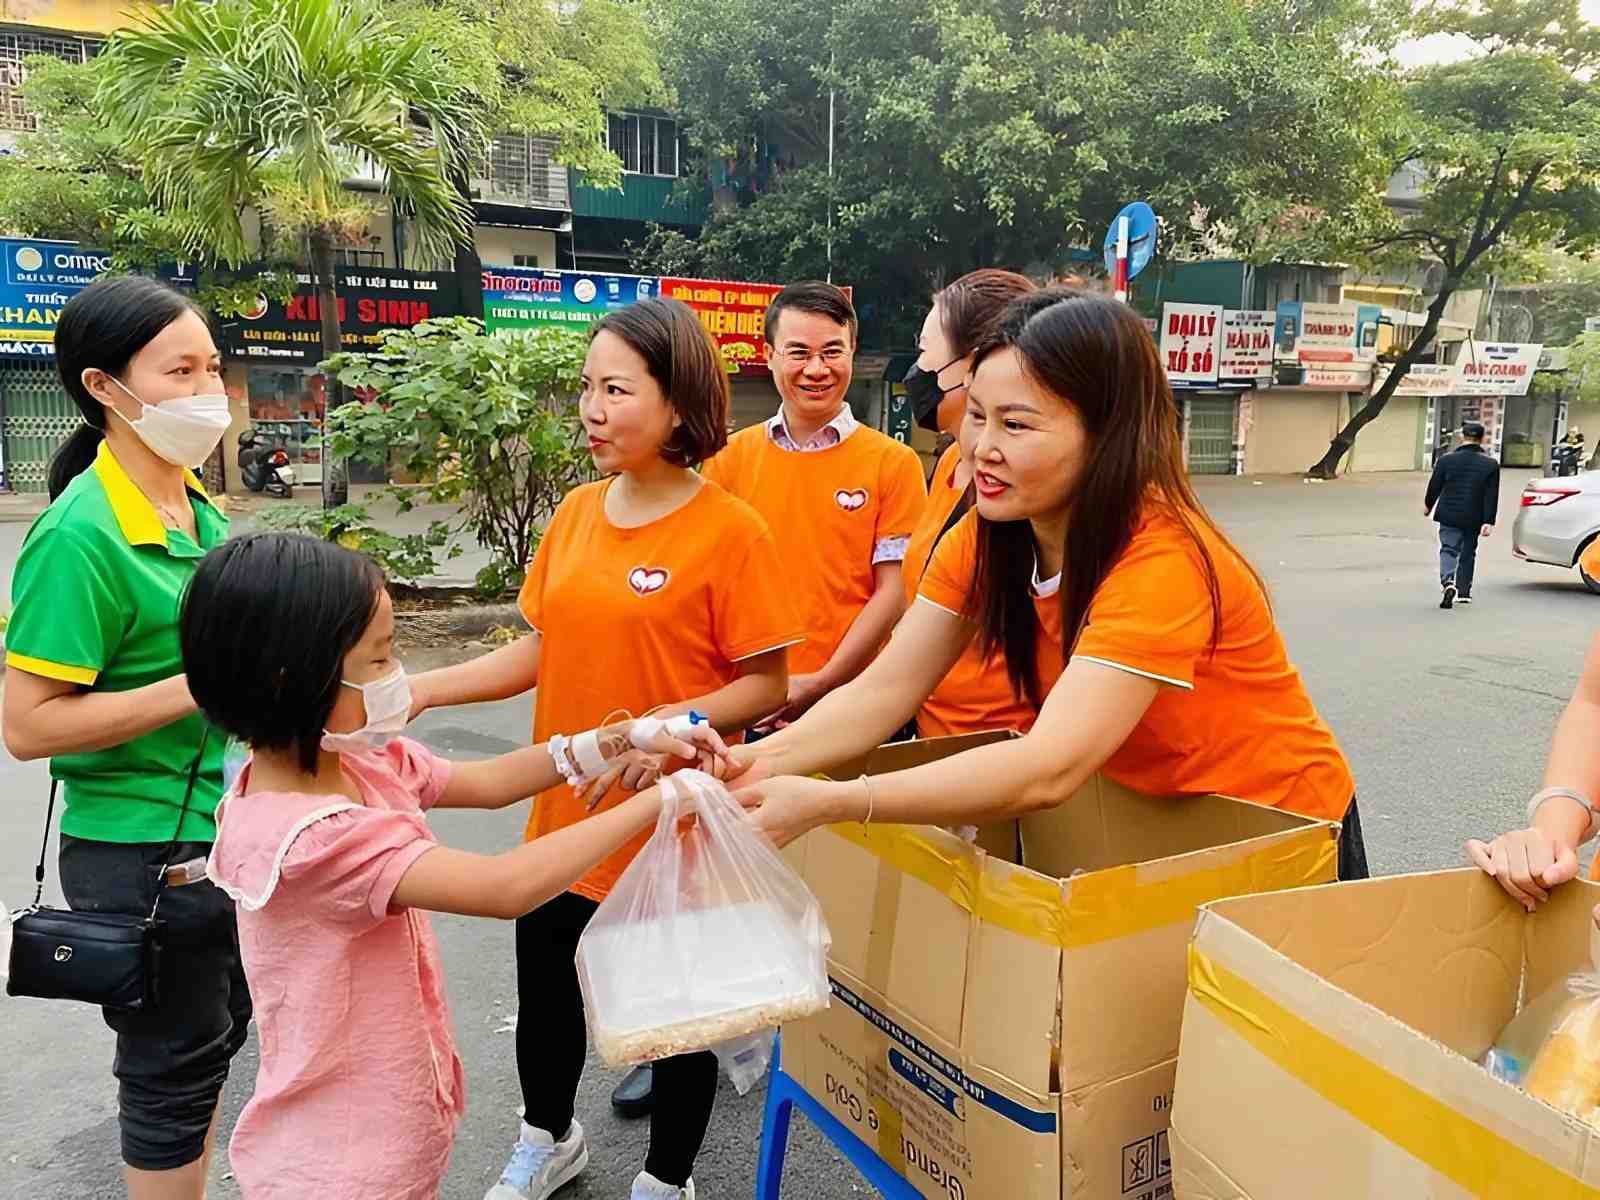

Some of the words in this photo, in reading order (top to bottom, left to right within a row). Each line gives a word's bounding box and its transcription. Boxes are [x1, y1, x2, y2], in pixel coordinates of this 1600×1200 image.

[54, 254, 113, 272] OMRO
[358, 299, 430, 324] SINH
[1168, 313, 1196, 340] ĐẠI
[1198, 310, 1217, 337] LÝ
[1167, 340, 1189, 373] XỔ
[1191, 342, 1213, 373] SỐ
